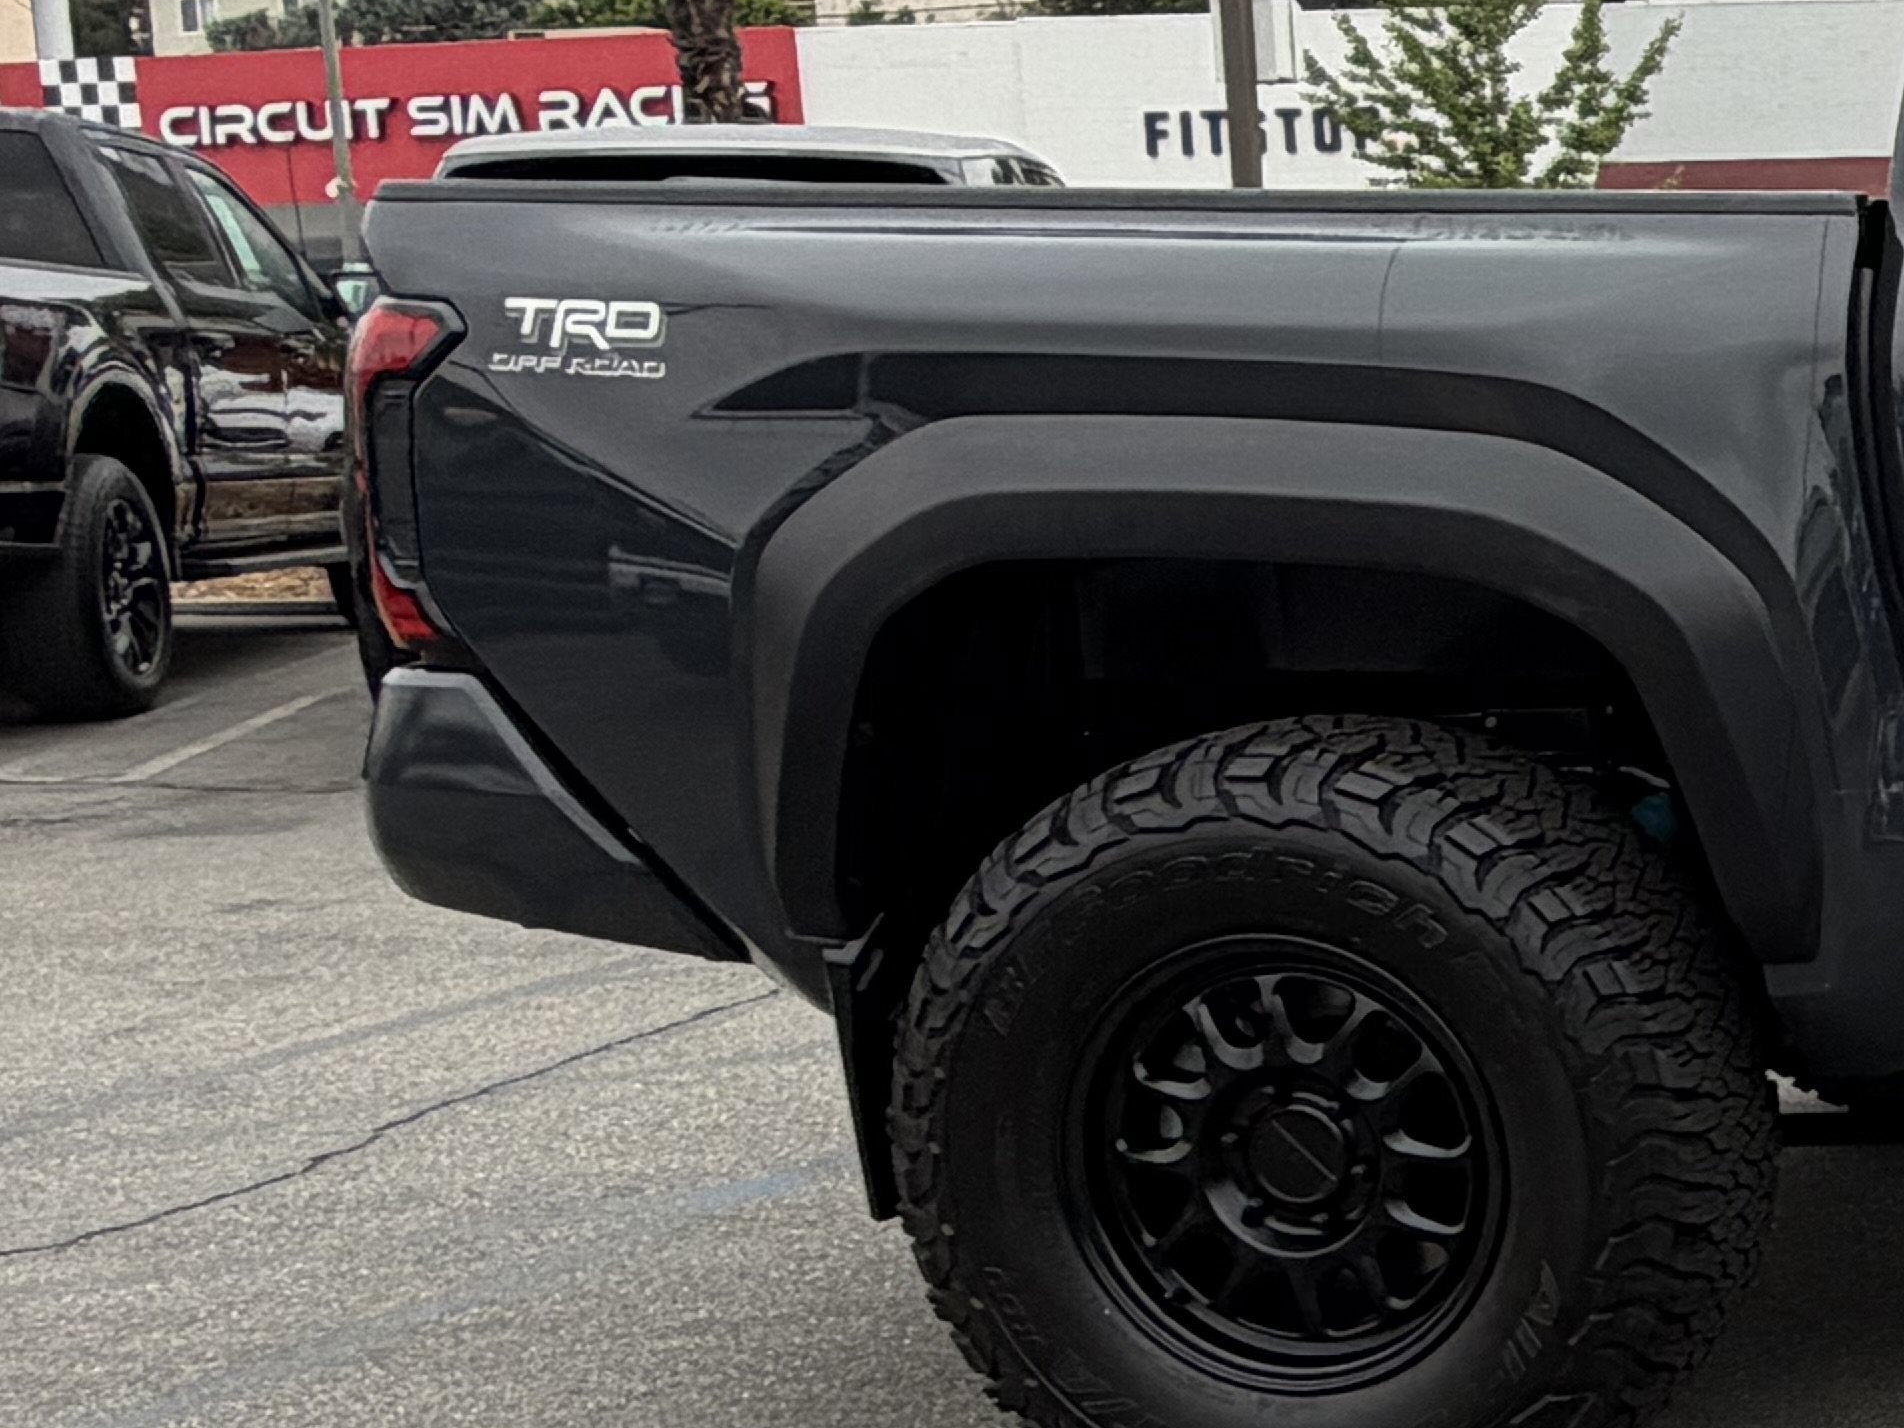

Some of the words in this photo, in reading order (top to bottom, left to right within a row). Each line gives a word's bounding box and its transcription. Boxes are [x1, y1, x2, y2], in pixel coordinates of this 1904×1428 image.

[160, 98, 391, 147] CIRCUIT
[407, 93, 523, 137] SIM
[504, 296, 666, 351] TRD
